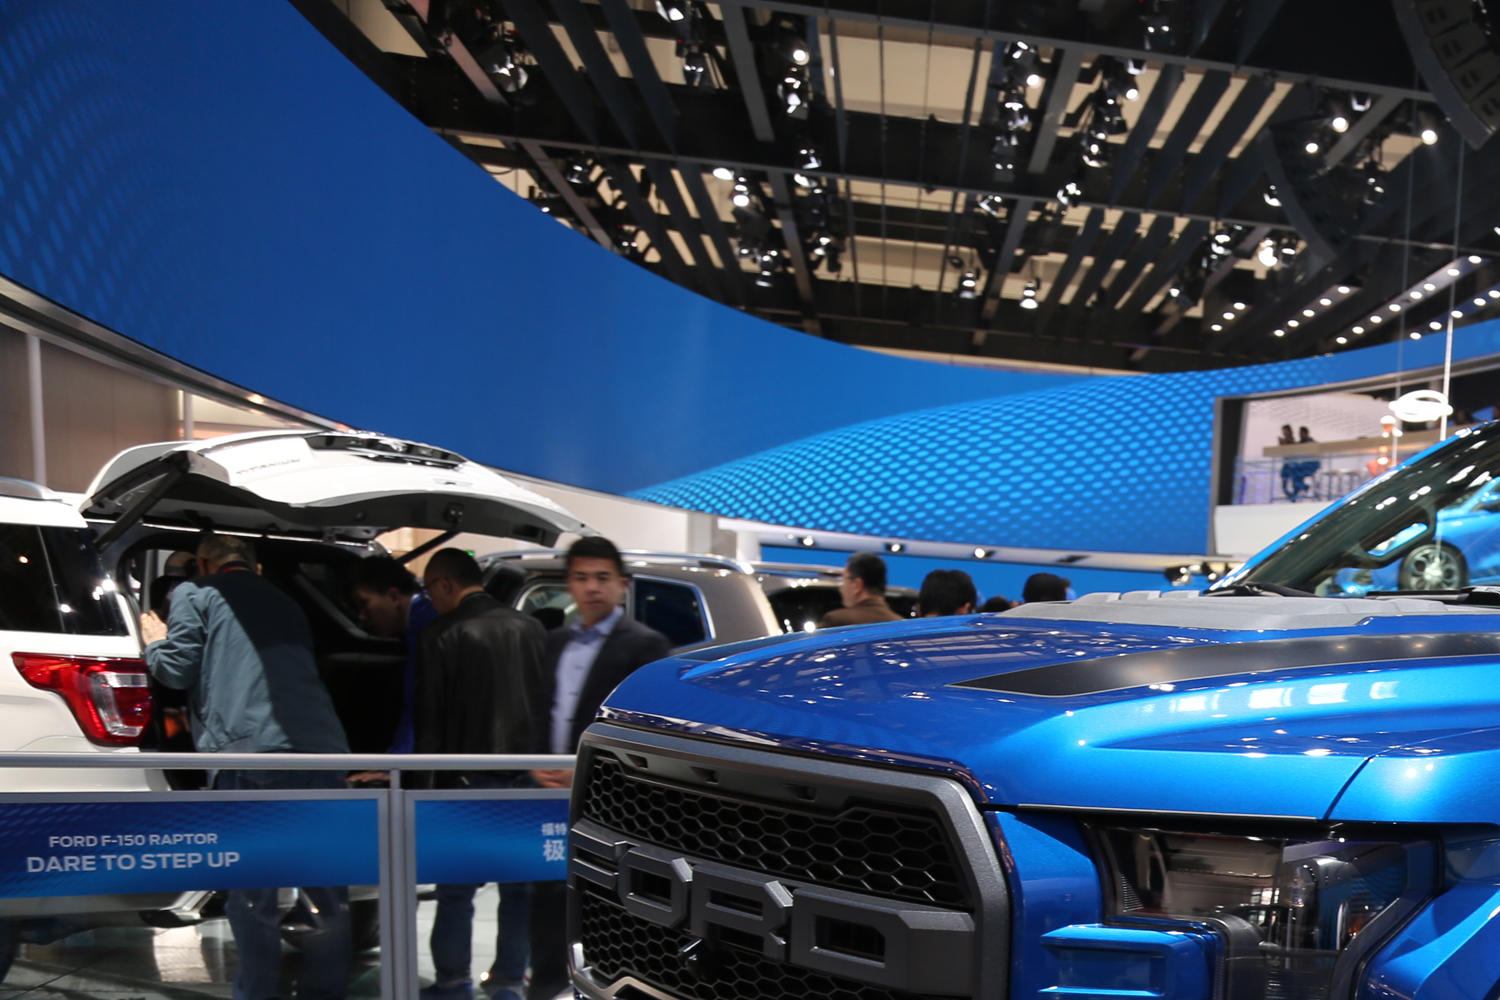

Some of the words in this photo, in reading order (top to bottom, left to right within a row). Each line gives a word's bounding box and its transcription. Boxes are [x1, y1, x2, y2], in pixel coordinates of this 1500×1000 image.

[49, 835, 98, 848] FORD
[101, 834, 146, 847] F-150
[149, 833, 218, 846] RAPTOR
[27, 855, 97, 873] DARE
[101, 853, 136, 871] TO
[141, 852, 203, 870] STEP
[207, 851, 240, 868] UP
[570, 826, 912, 988] FORD
